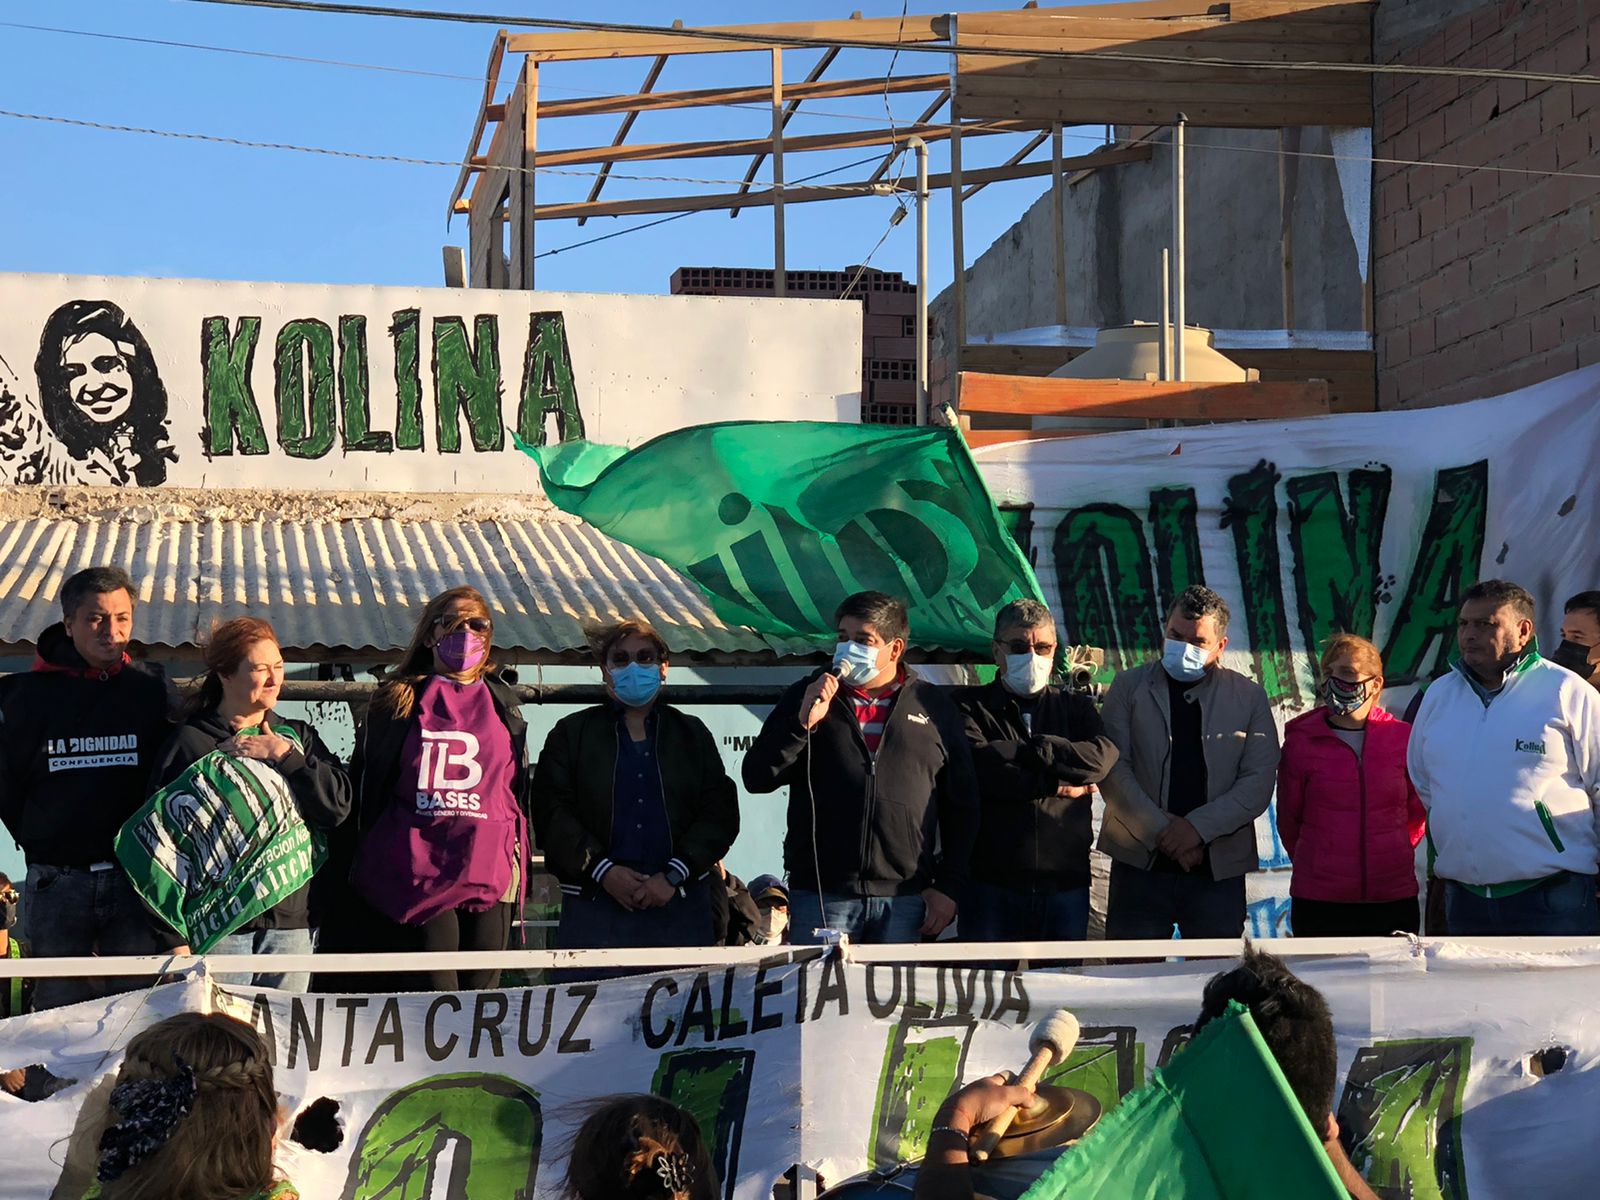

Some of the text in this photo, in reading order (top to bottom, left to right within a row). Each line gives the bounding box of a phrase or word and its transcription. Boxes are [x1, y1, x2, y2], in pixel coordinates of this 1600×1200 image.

[201, 307, 586, 460] KOLINA
[48, 739, 67, 754] LA
[52, 756, 135, 767] CONFLUENCIA
[416, 791, 481, 811] BASES
[211, 985, 404, 1071] ANTA
[424, 985, 598, 1061] CRUZ
